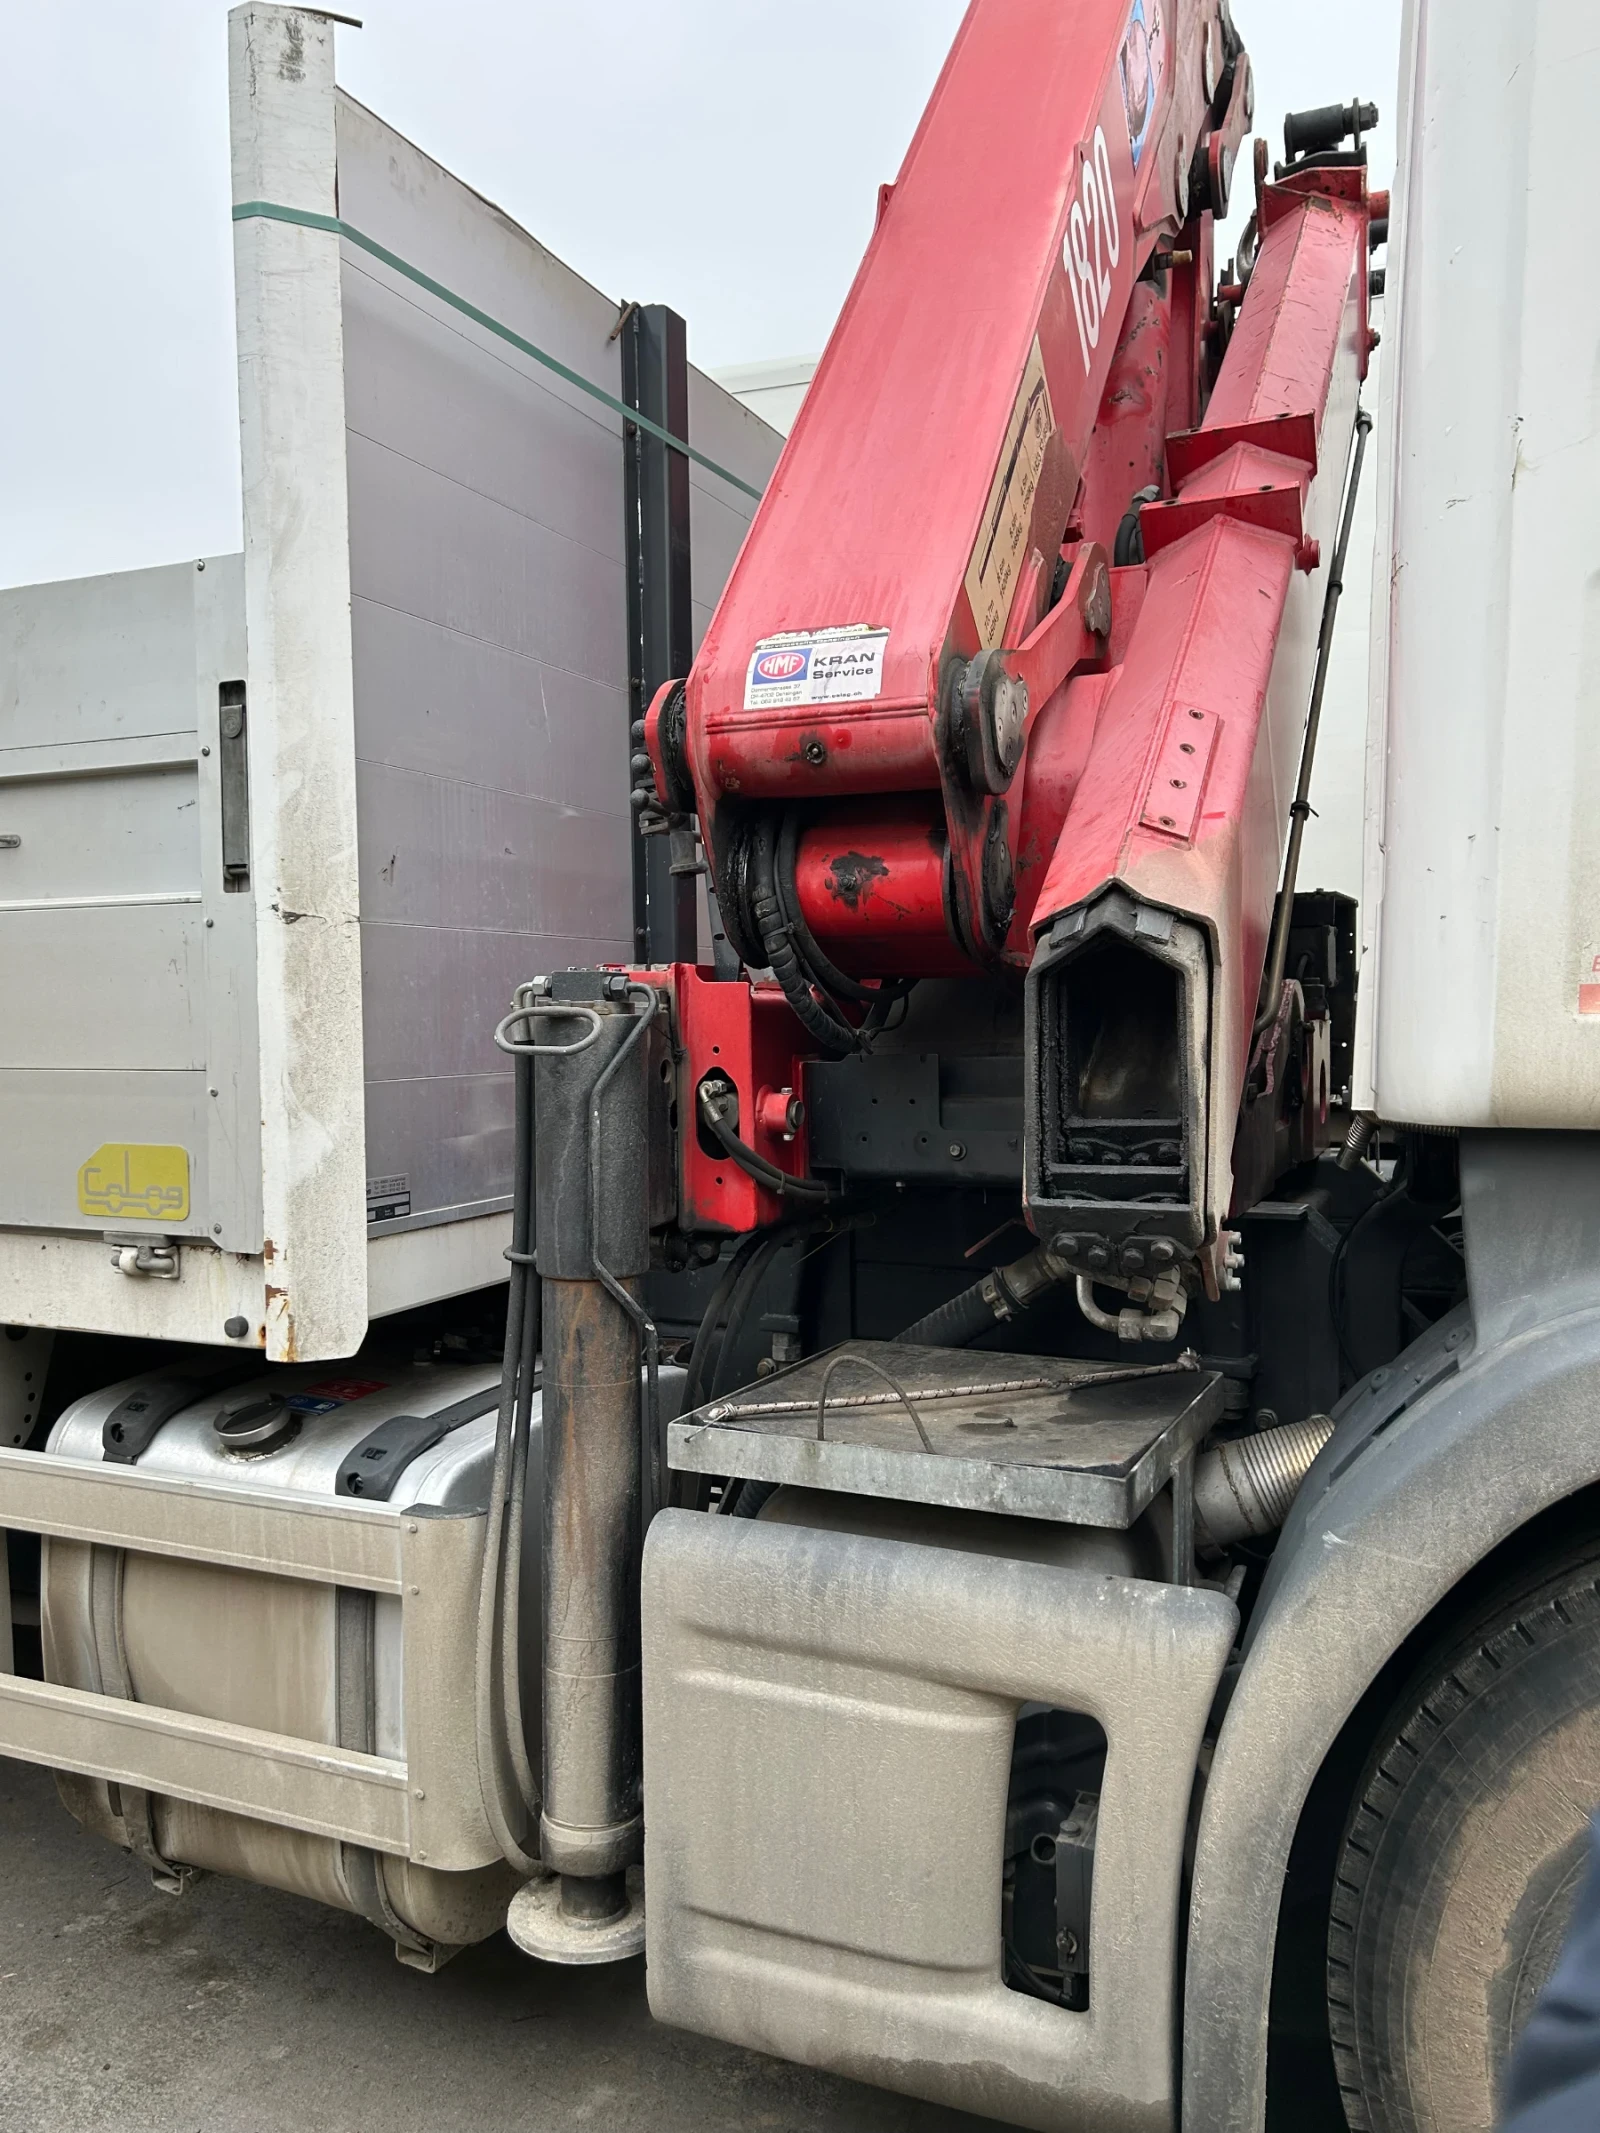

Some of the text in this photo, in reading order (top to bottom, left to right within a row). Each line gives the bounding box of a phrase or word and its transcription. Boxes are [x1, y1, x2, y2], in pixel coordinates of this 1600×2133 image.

[1063, 125, 1119, 377] 1820
[763, 655, 799, 675] HMF
[813, 652, 875, 667] KRAN
[812, 667, 873, 679] Service
